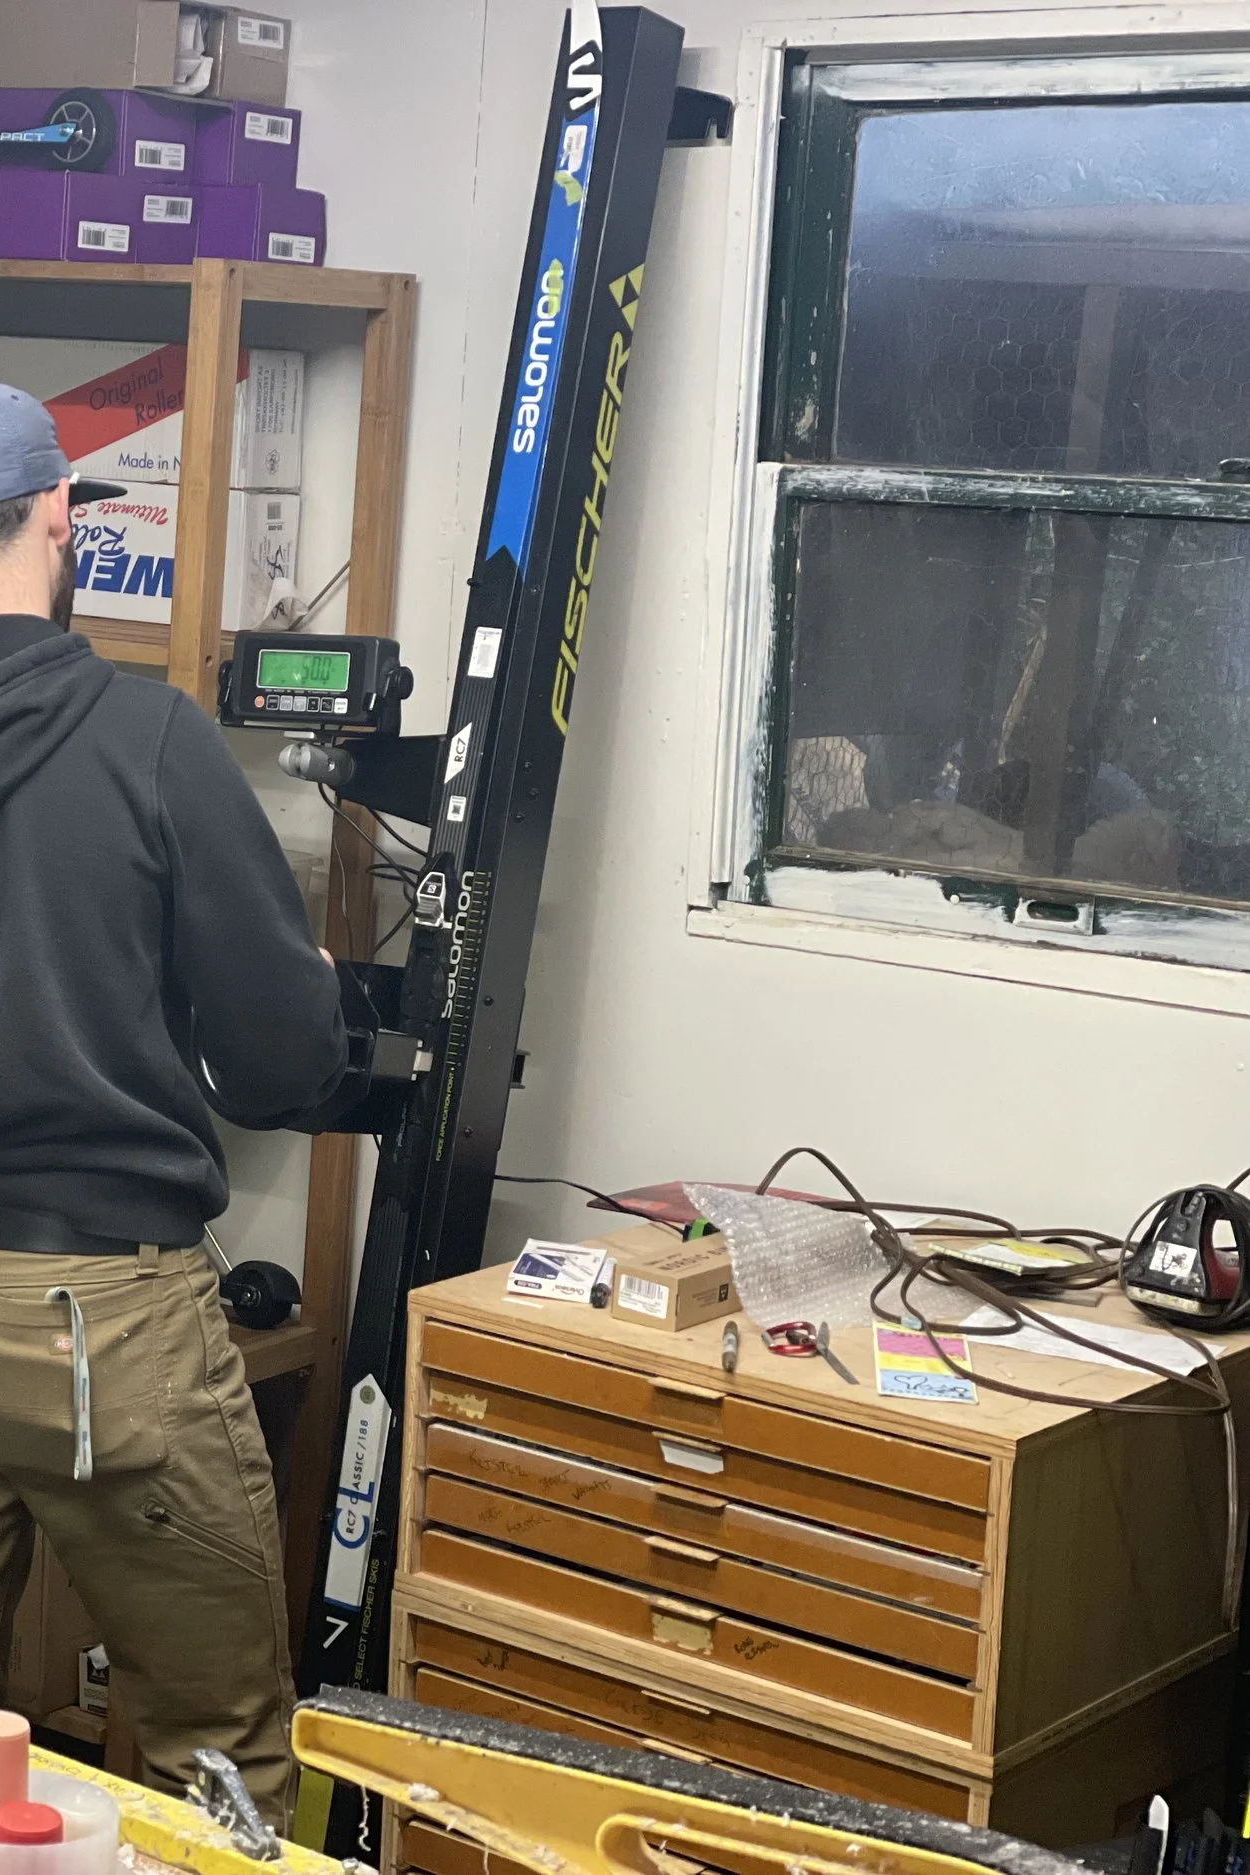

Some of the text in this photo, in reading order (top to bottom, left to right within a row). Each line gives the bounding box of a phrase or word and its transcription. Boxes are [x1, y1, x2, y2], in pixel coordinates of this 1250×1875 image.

[90, 346, 163, 411] Original
[118, 452, 155, 470] Made
[158, 455, 169, 471] in
[97, 502, 170, 526] Ultimate
[551, 330, 631, 737] FISCHER
[454, 737, 466, 763] RC7
[346, 1509, 357, 1535] RC7
[353, 1636, 367, 1681] SELECT
[360, 1586, 376, 1635] FISCHER
[368, 1558, 380, 1584] SKIS
